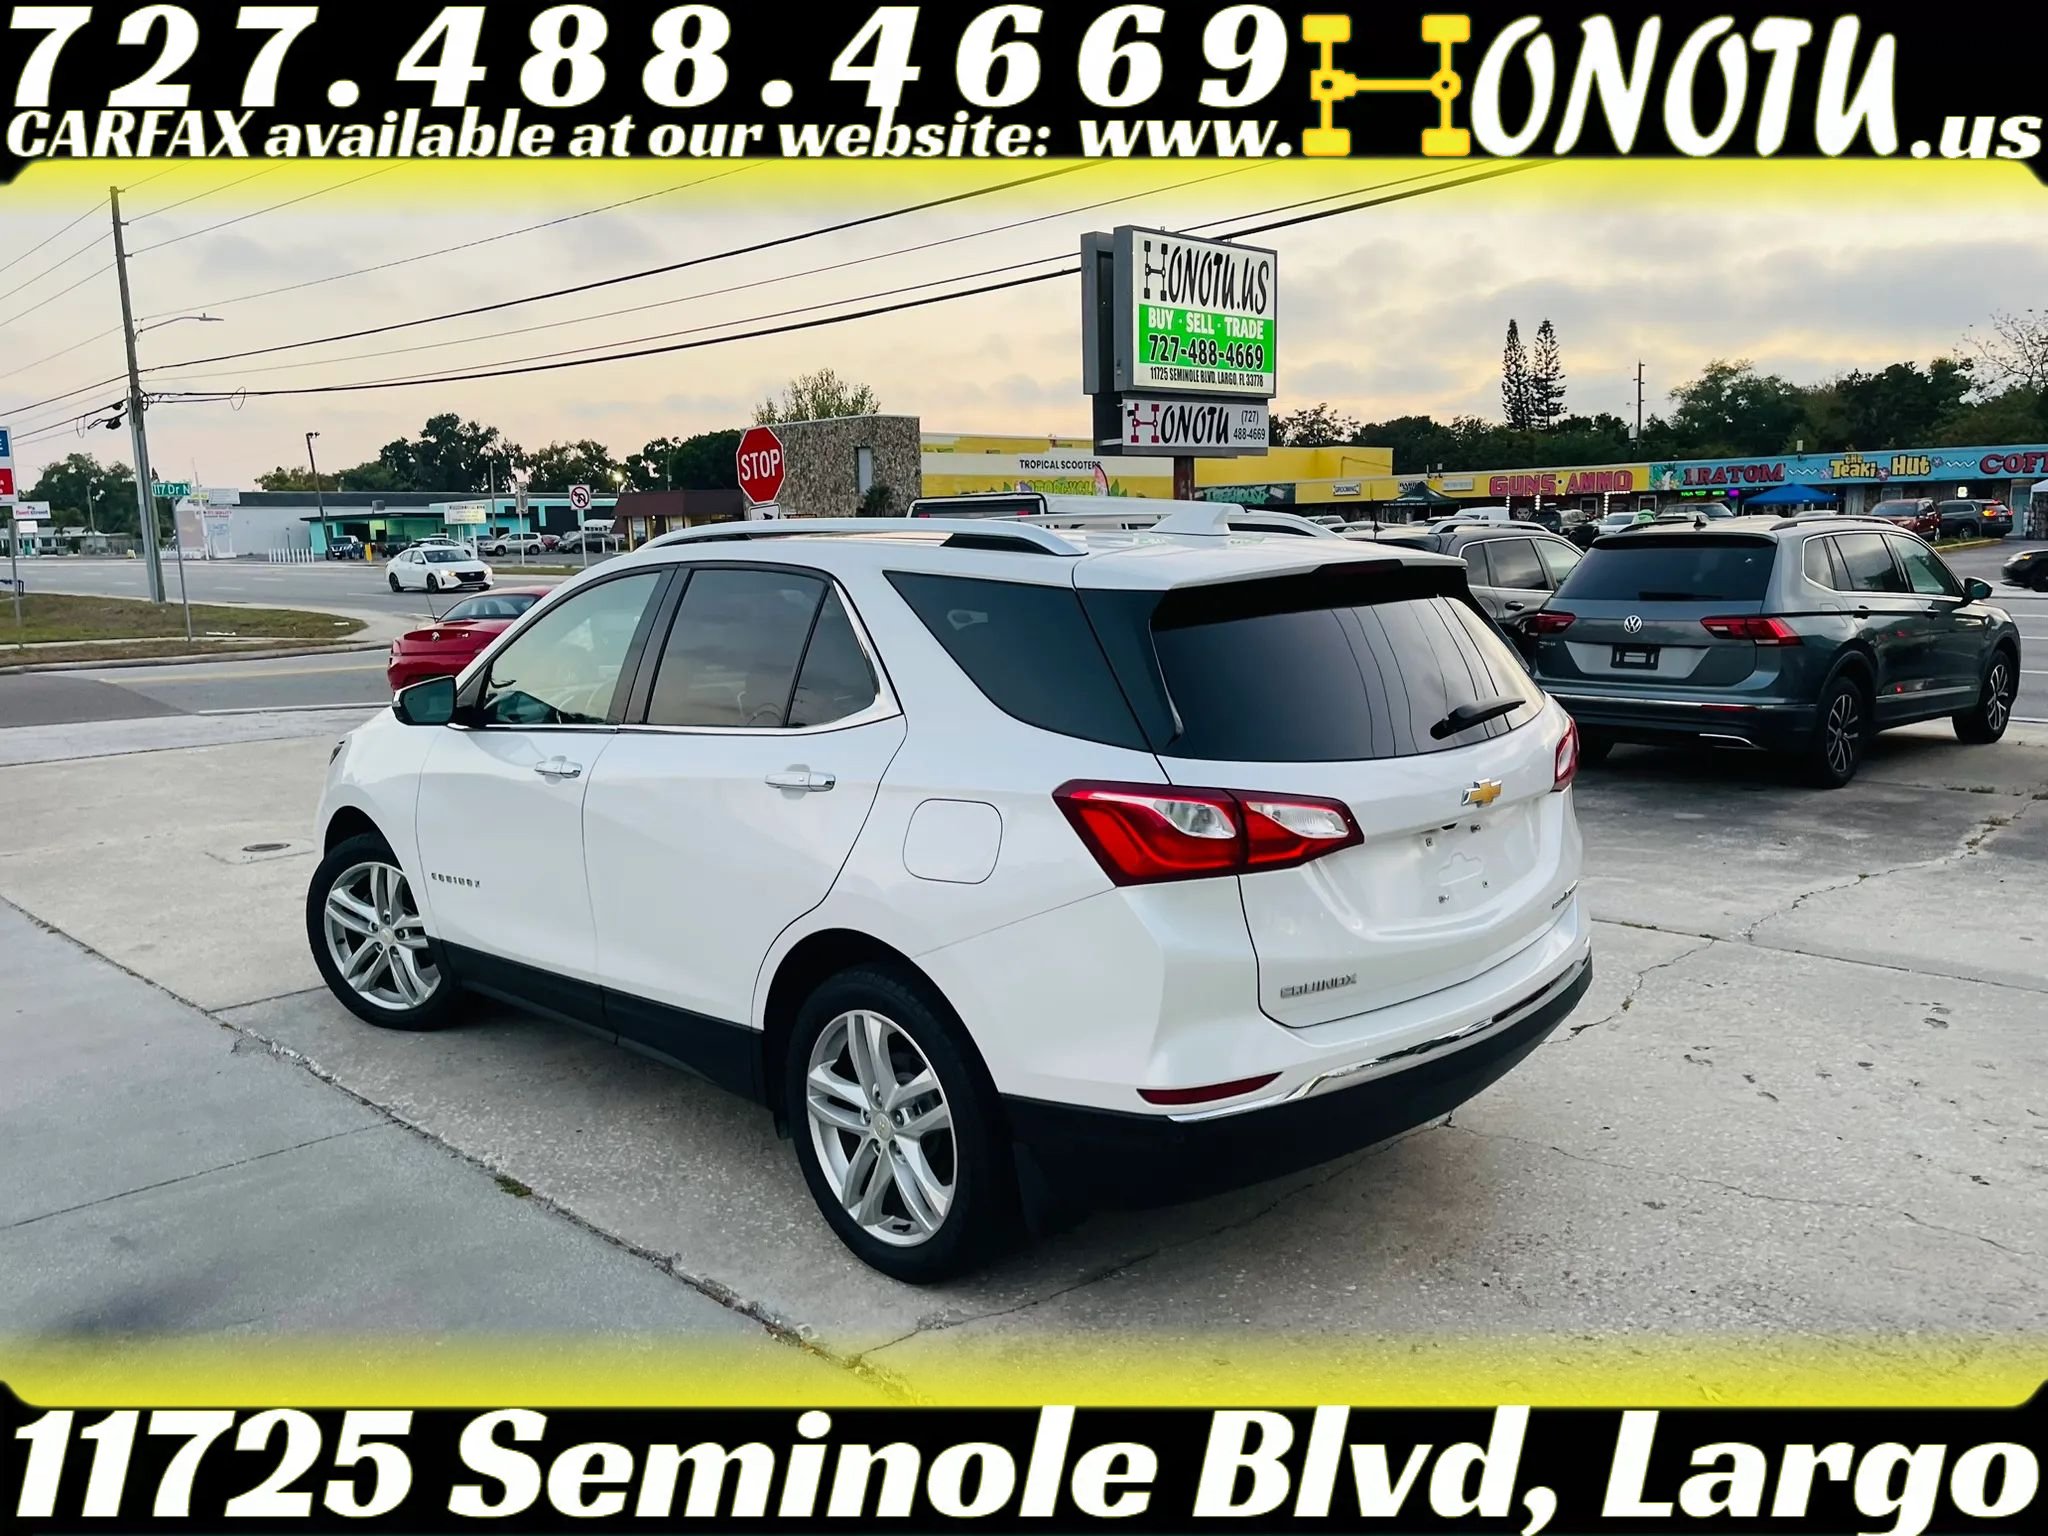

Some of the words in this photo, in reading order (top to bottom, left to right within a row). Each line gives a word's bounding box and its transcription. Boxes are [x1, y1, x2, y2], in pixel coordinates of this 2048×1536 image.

[1148, 307, 1174, 330] BUY
[1186, 311, 1214, 335] SELL
[1224, 317, 1264, 340] TRADE
[1148, 334, 1264, 370] 727-488-4669
[1150, 366, 1168, 381] 11725
[1169, 368, 1199, 383] SEMINOLE
[1239, 373, 1246, 387] FL
[1246, 374, 1264, 387] 33778
[1241, 410, 1259, 425] (727)
[1233, 428, 1266, 441] 488-4669
[740, 449, 780, 481] STOP
[1019, 459, 1059, 470] TROPICAL
[1830, 459, 1877, 479] Teaki
[1891, 454, 1931, 476] Hut
[153, 484, 166, 495] 117
[168, 484, 180, 495] Dr
[183, 484, 190, 495] N
[1489, 474, 1556, 497] GUNS
[1565, 470, 1633, 495] AMMO
